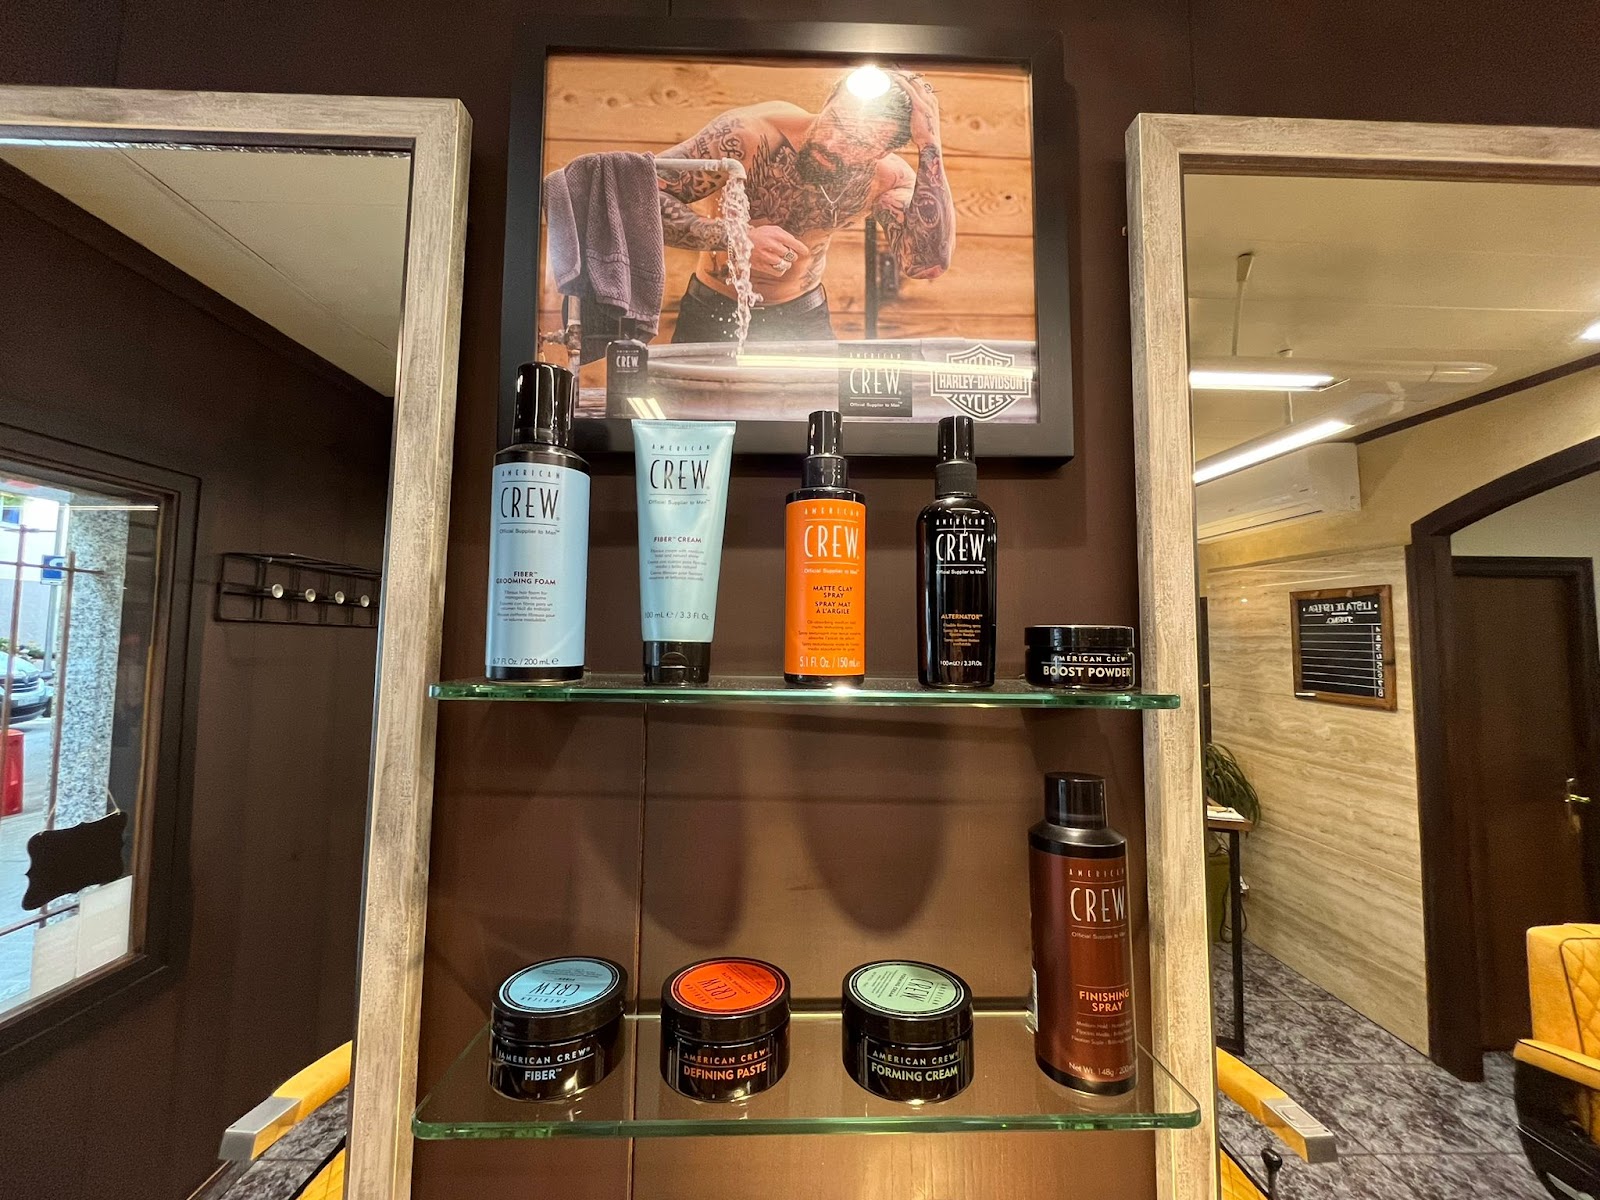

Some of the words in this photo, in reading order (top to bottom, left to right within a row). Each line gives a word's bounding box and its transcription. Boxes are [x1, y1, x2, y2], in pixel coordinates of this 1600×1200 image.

[616, 355, 639, 368] CREW
[849, 366, 901, 395] CREW
[939, 374, 1024, 390] HARLEY-DAVIDSON
[959, 393, 1004, 413] CYCLES
[652, 443, 710, 452] AMERICAN
[501, 468, 560, 479] AMERICAN
[650, 459, 709, 490] CREW
[500, 486, 559, 520] CREW
[804, 525, 859, 559] CREW
[936, 533, 985, 561] CREW
[495, 577, 532, 585] GROOMING
[837, 656, 848, 668] 150
[1043, 666, 1084, 677] BOOST
[1088, 667, 1132, 678] POWDER
[1070, 885, 1125, 922] CREW
[529, 981, 581, 997] CREW
[697, 977, 737, 1001] CREW
[902, 978, 934, 1003] CREW
[1079, 988, 1130, 1002] FINISHING
[1091, 1001, 1123, 1012] SPRAY
[501, 1051, 551, 1065] AMERICAN
[683, 1052, 735, 1065] AMERICAN
[872, 1050, 926, 1065] AMERICAN
[683, 1065, 734, 1081] DEFINING
[736, 1060, 767, 1079] PASTE
[871, 1061, 922, 1081] FORMING
[925, 1065, 958, 1081] CREAM
[1068, 1061, 1081, 1071] Net
[1098, 1067, 1115, 1077] 148g
